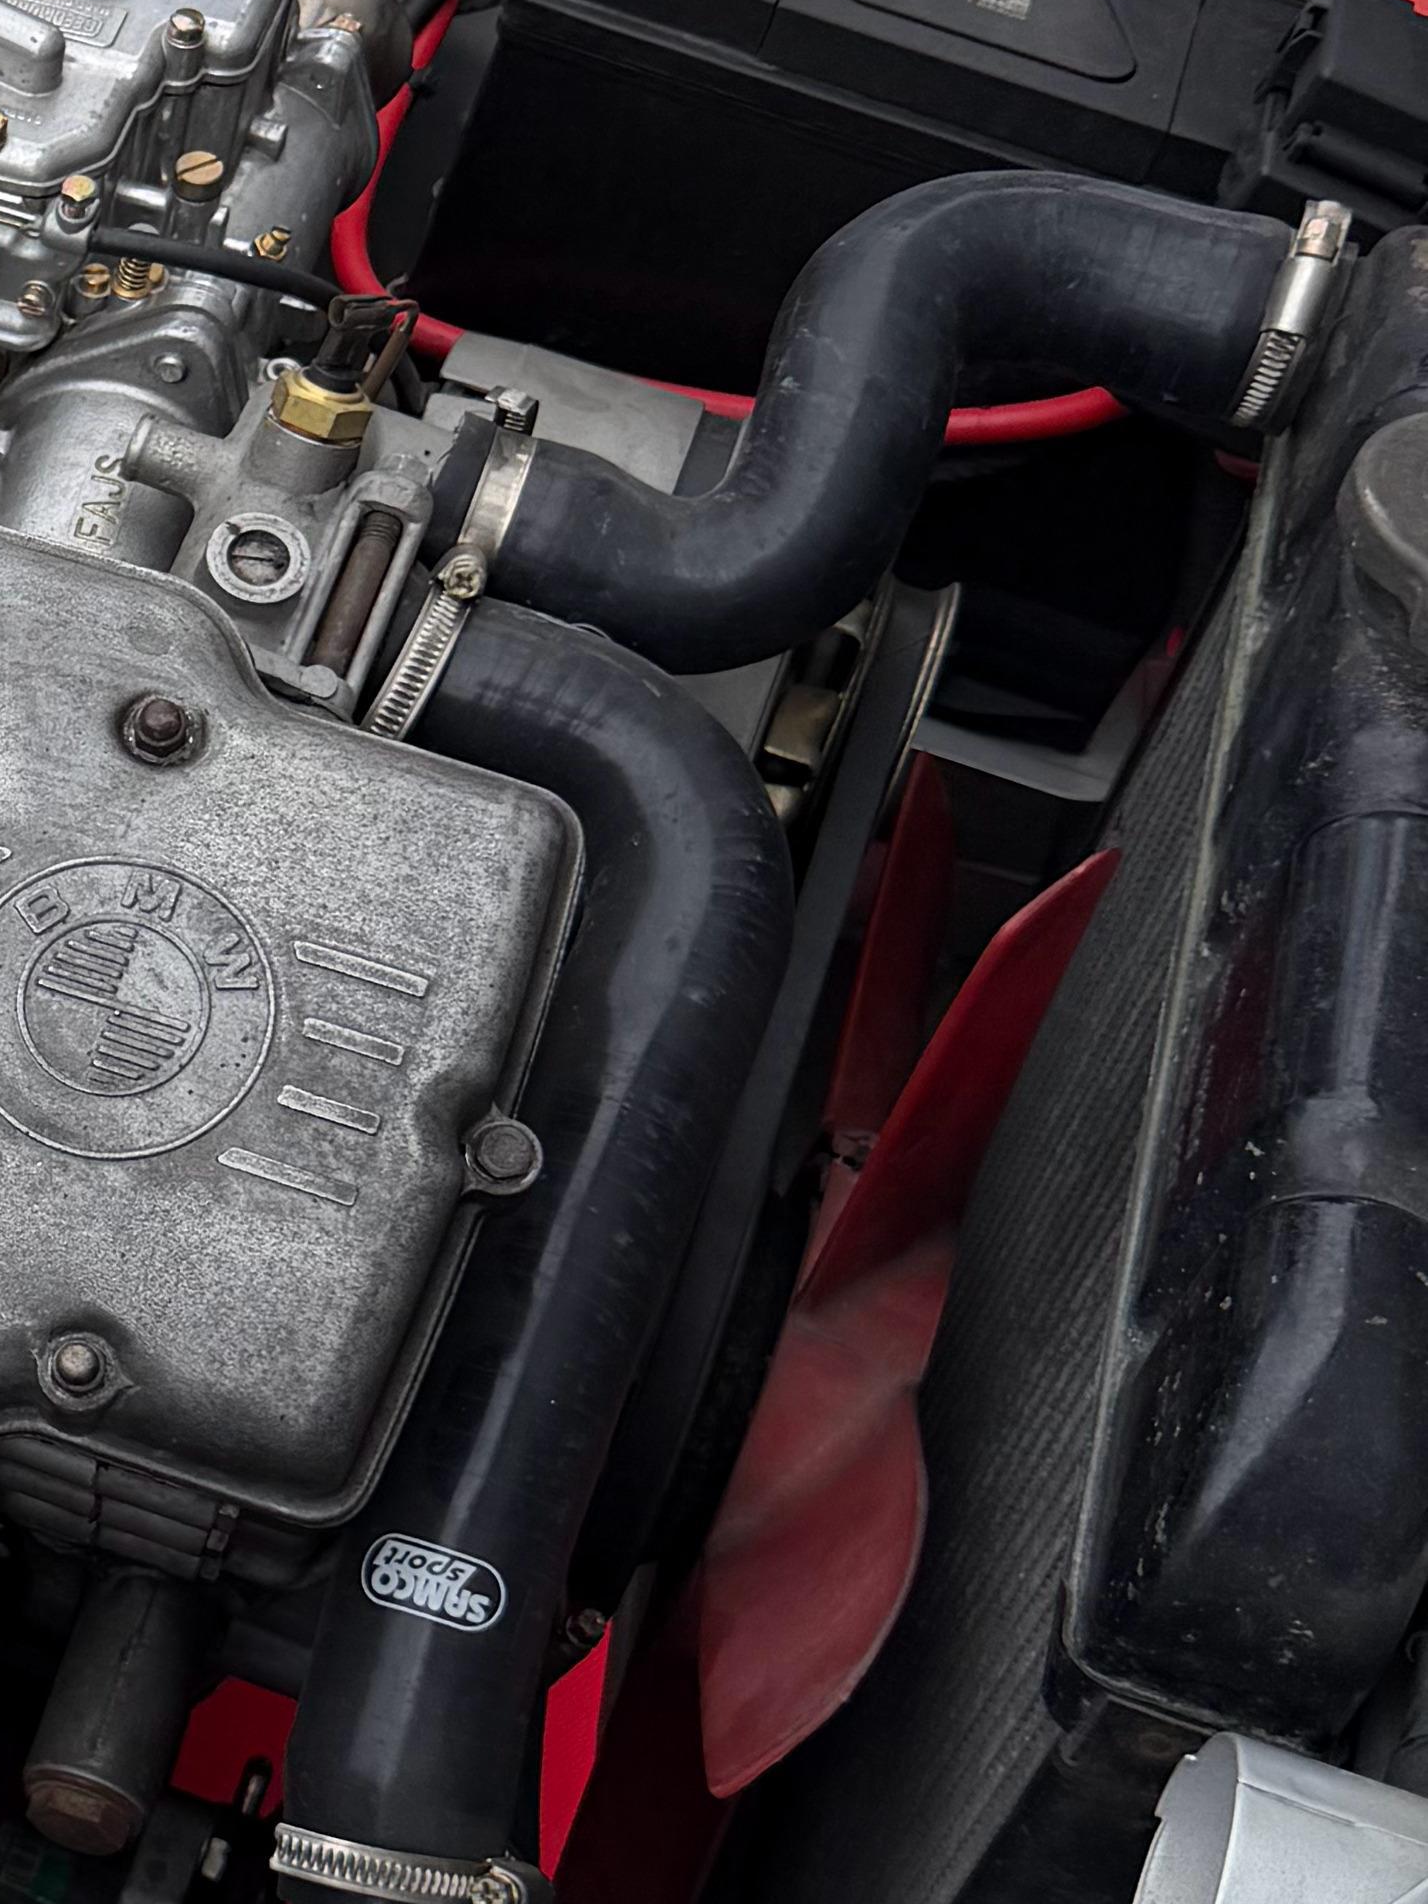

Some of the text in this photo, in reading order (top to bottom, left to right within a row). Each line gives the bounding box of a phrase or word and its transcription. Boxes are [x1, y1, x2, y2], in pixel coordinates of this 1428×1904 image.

[73, 454, 127, 547] FAJS
[13, 871, 261, 991] BMW
[371, 1563, 492, 1624] SAMCO
[383, 1546, 465, 1582] sport
